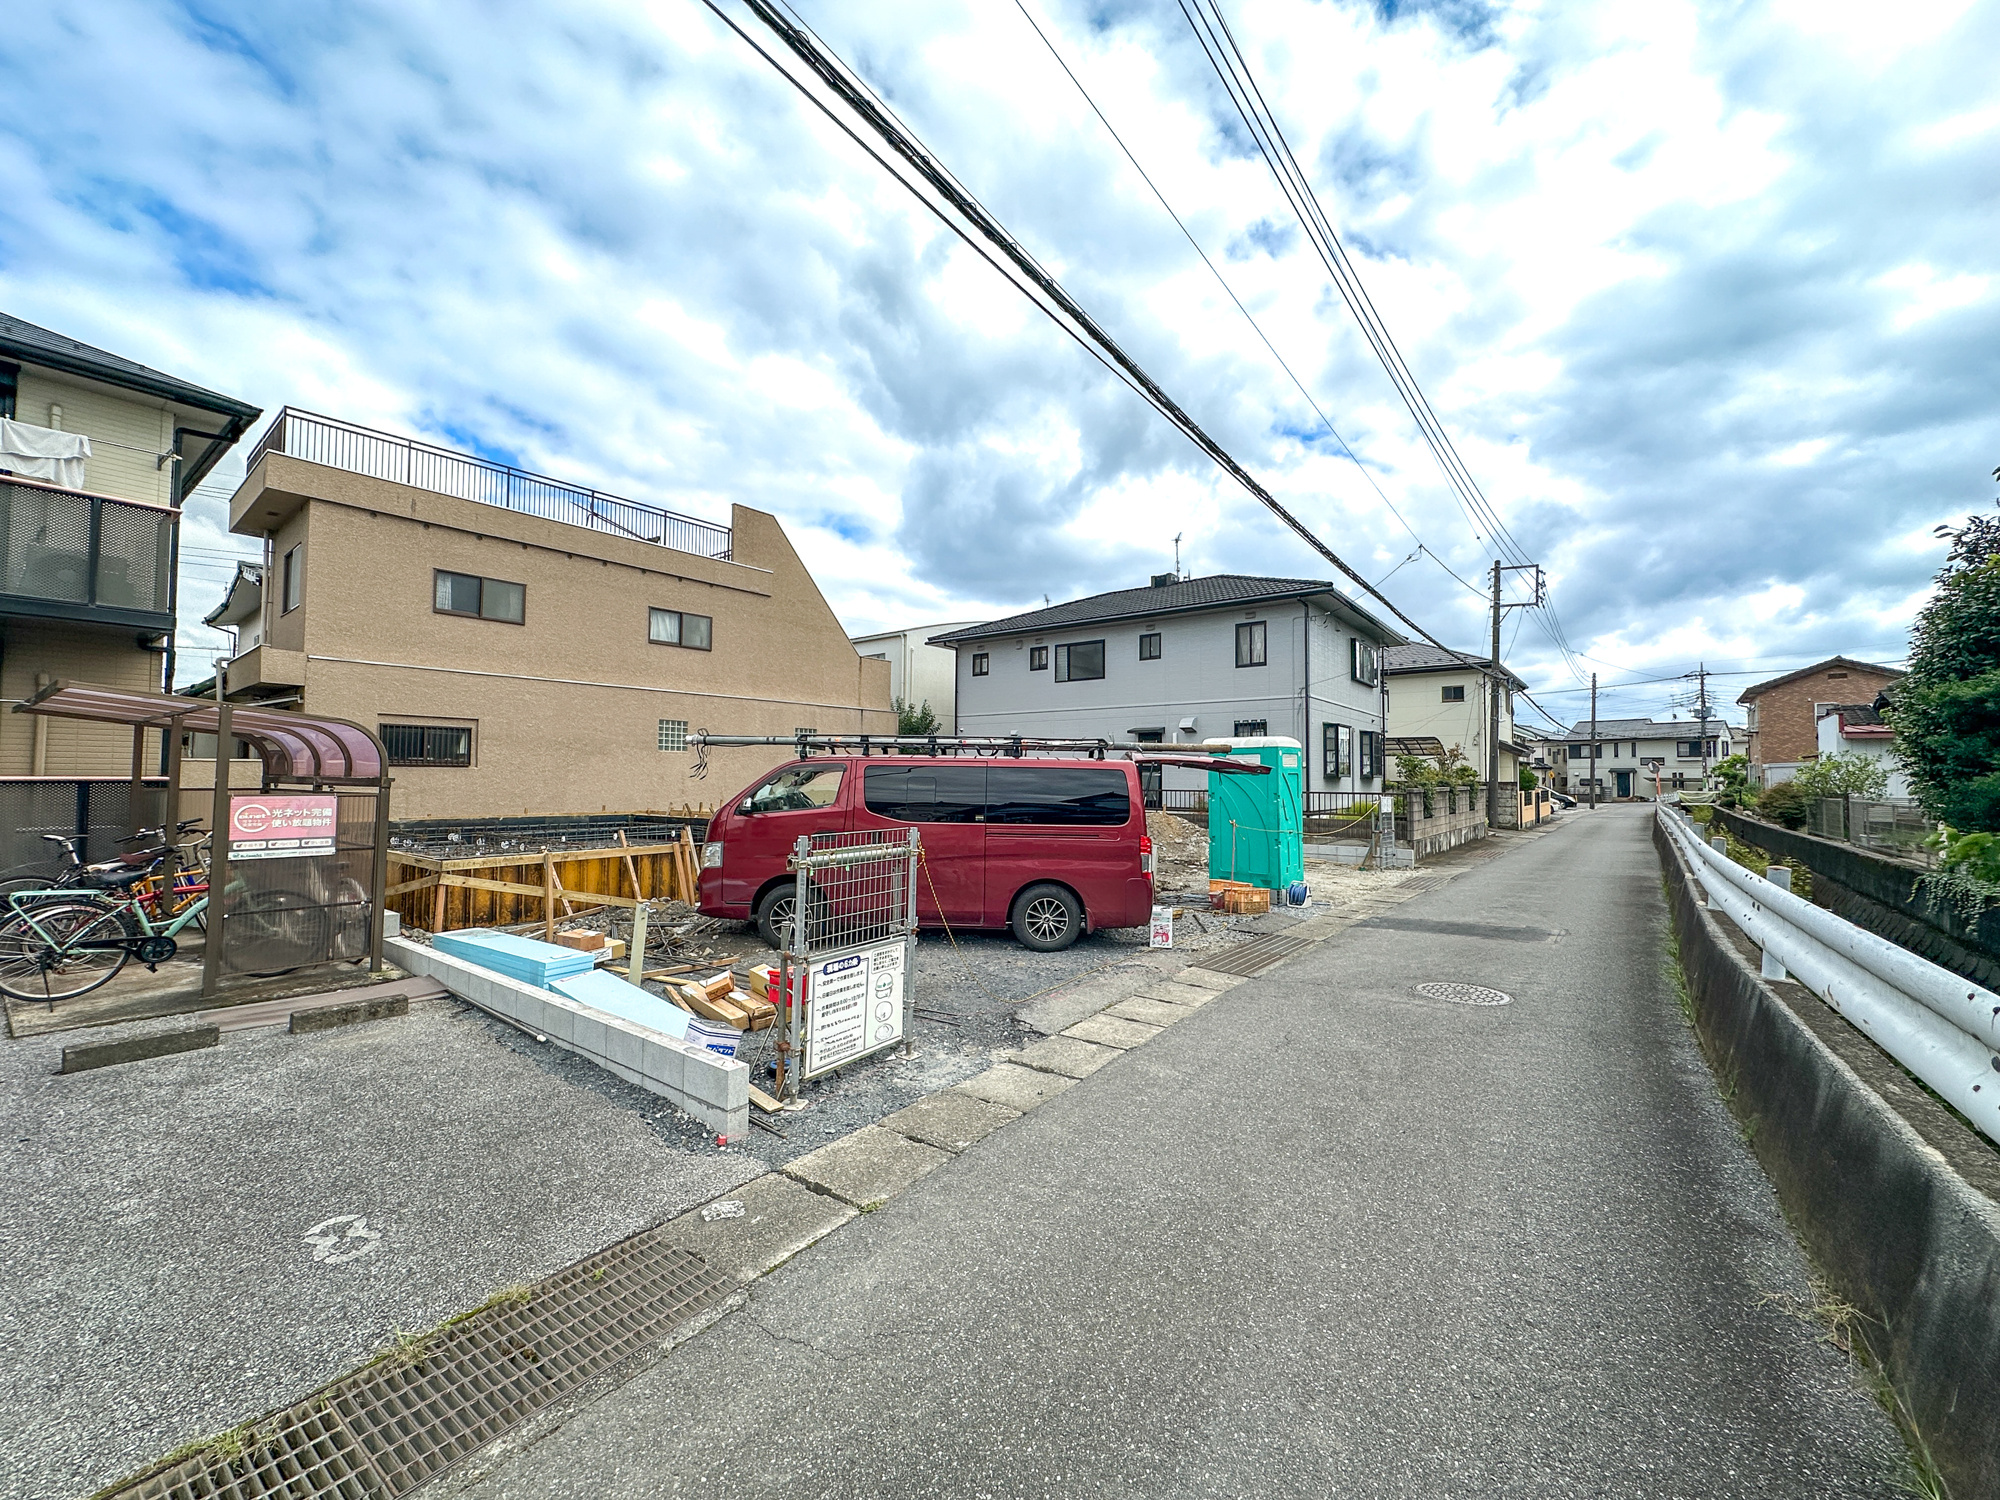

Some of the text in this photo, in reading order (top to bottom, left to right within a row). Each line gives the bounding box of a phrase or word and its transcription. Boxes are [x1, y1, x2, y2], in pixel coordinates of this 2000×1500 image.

[272, 808, 332, 818] 光ネット完備
[271, 818, 332, 828] 使い放題物件
